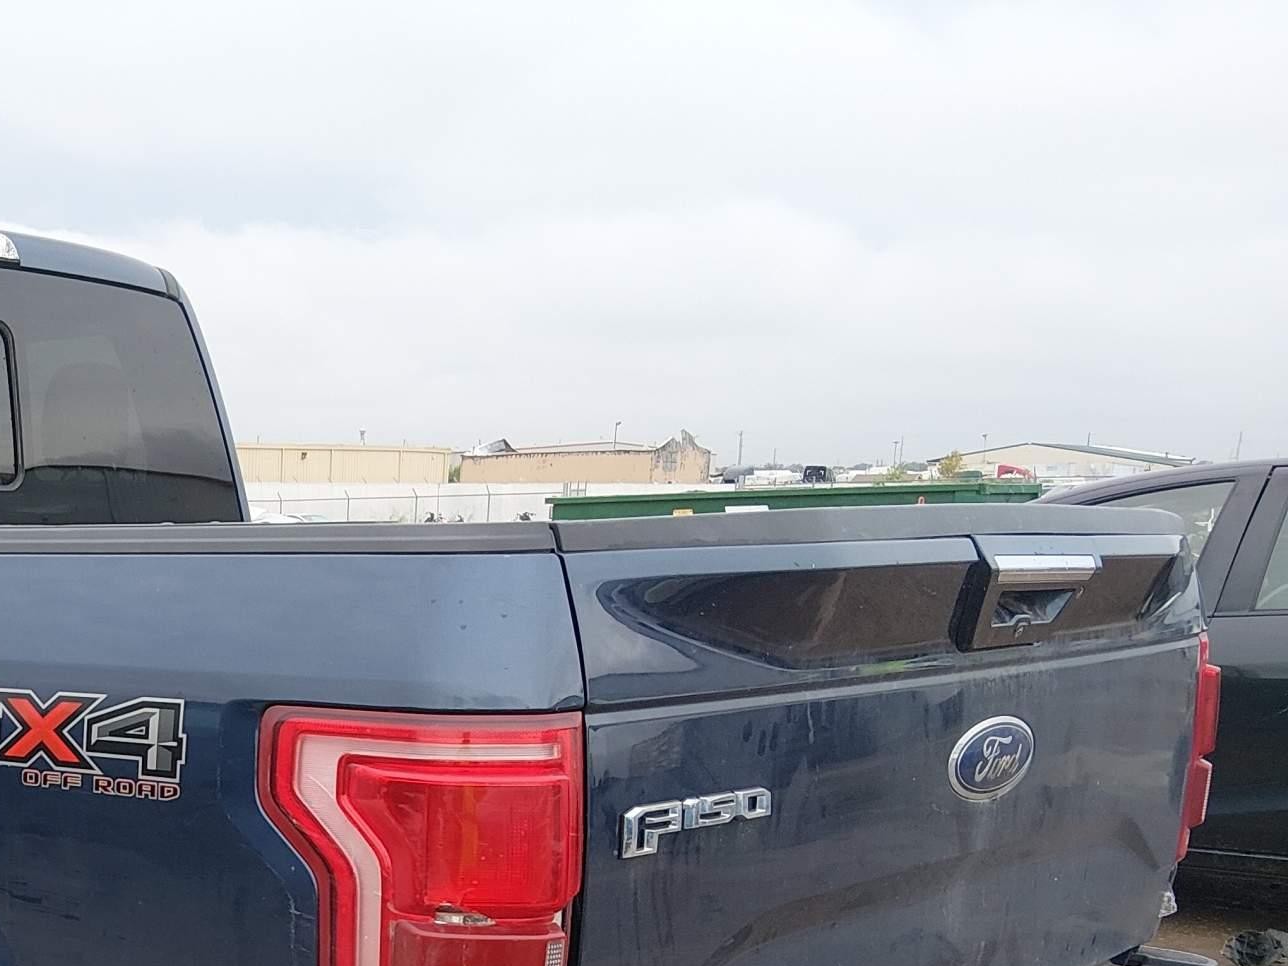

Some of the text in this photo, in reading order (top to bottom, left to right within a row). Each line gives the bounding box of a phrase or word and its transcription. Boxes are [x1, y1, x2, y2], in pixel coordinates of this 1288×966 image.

[975, 735, 1023, 783] Ford
[22, 769, 180, 801] OFF ROAD
